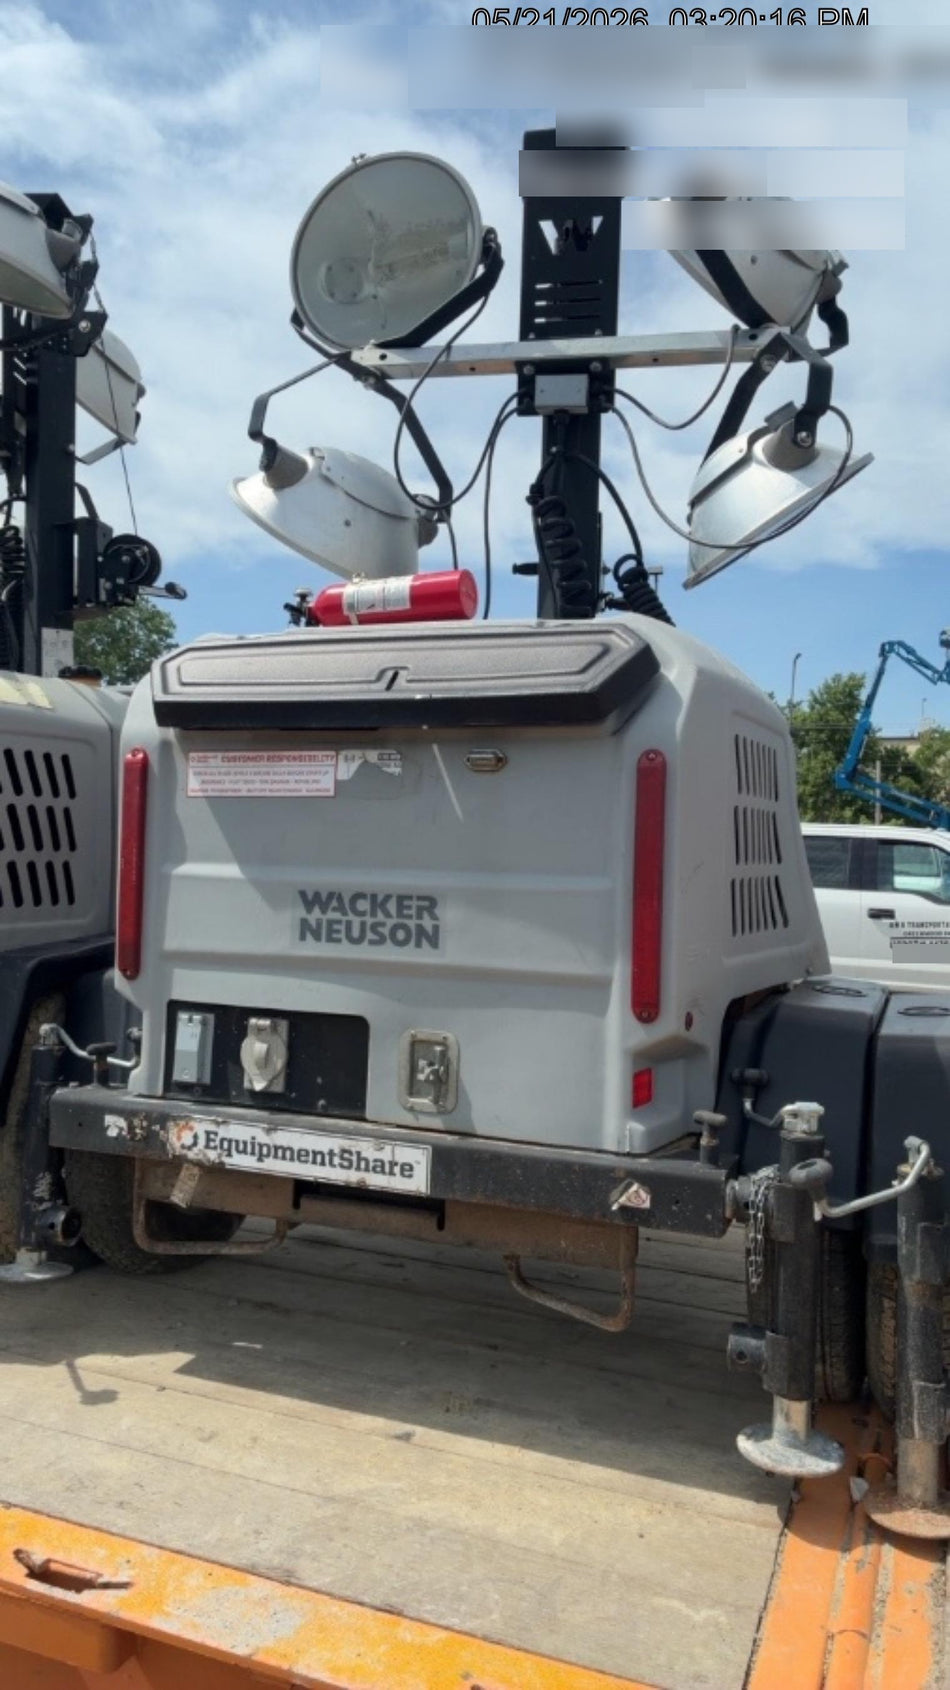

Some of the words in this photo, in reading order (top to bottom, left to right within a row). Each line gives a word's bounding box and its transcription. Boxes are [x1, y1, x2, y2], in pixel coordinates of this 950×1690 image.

[298, 890, 440, 921] WACKER
[298, 917, 440, 949] NEUSON
[203, 1129, 414, 1179] EquipmentShare
